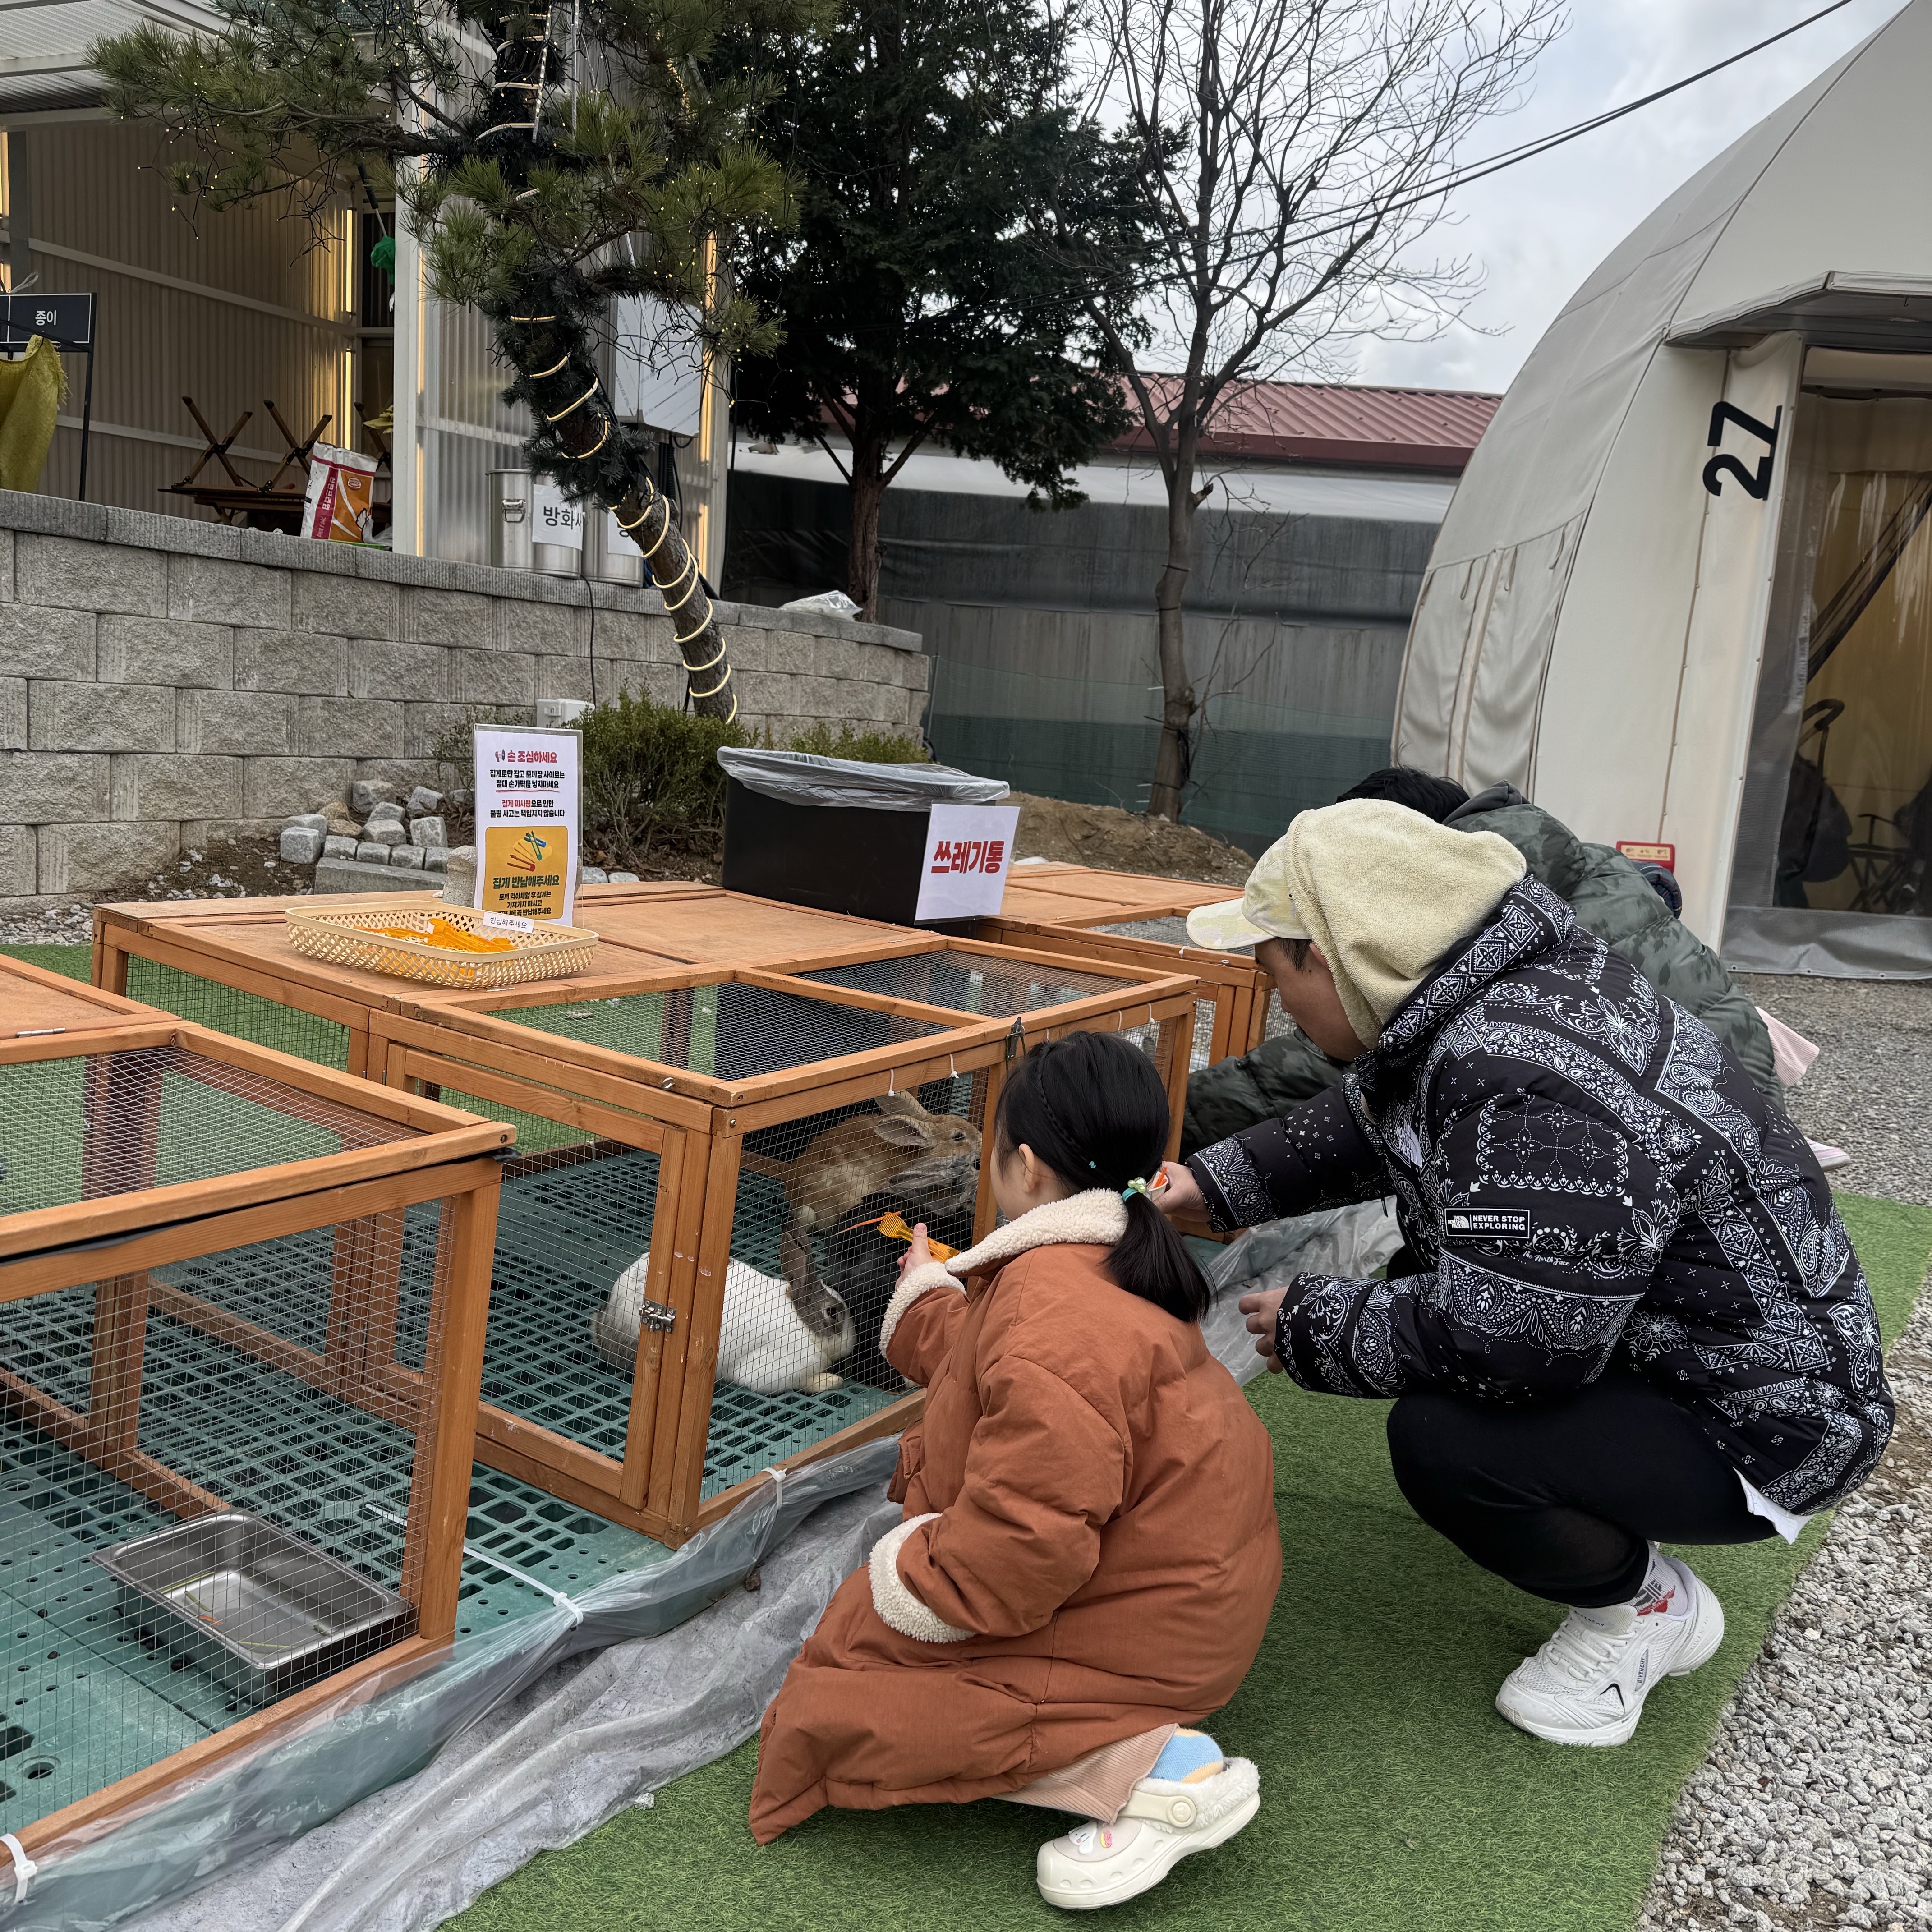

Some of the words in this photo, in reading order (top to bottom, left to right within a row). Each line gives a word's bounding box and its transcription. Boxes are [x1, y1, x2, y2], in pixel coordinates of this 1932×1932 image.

[35, 310, 56, 326] 종이
[1702, 401, 1780, 500] 27
[507, 750, 516, 762] 손
[517, 751, 557, 763] 조심하세요
[502, 800, 514, 808] 집게
[515, 800, 542, 808] 미사용으로
[503, 810, 520, 818] 사고는
[931, 841, 1005, 874] 쓰레기통
[493, 877, 511, 889] 집게
[512, 875, 559, 888] 반납해주세요
